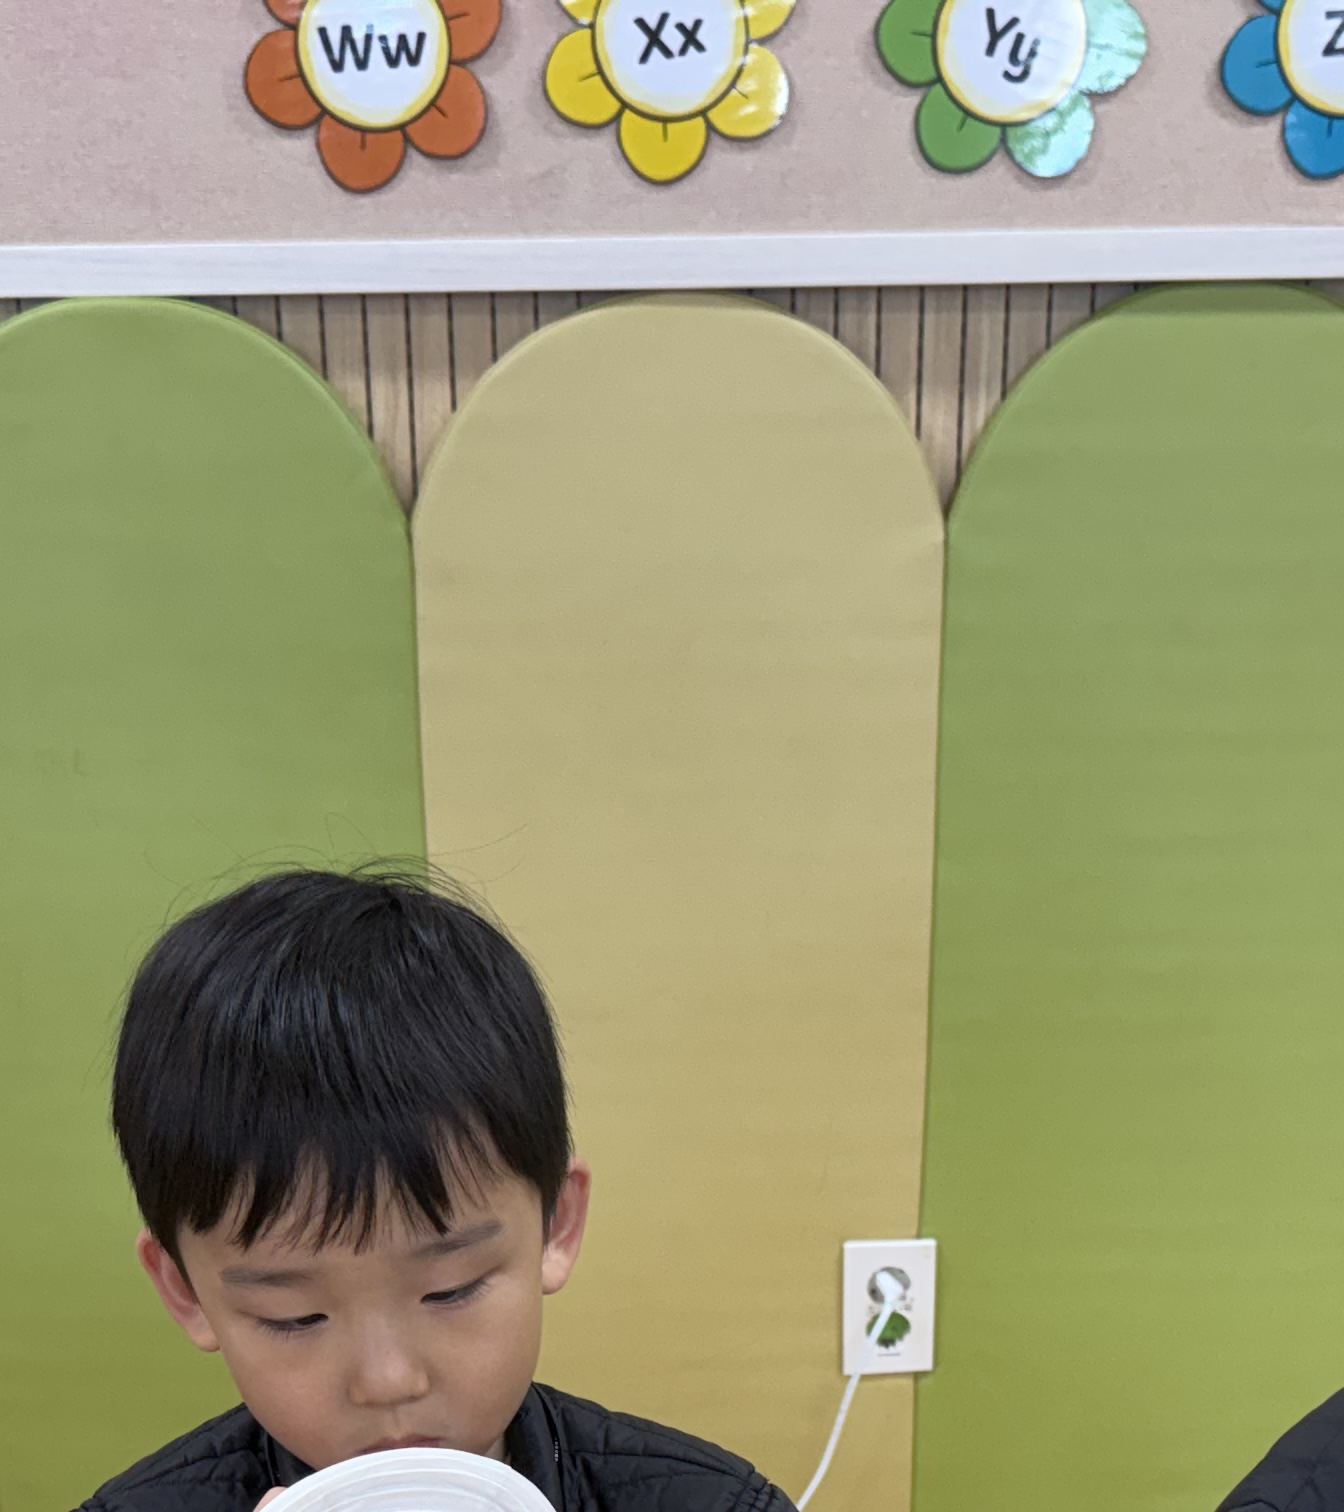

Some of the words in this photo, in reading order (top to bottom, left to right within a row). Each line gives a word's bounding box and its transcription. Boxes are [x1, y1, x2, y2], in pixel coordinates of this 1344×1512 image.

[317, 23, 427, 73] Ww
[633, 12, 707, 65] Xx
[982, 7, 1042, 84] Yy
